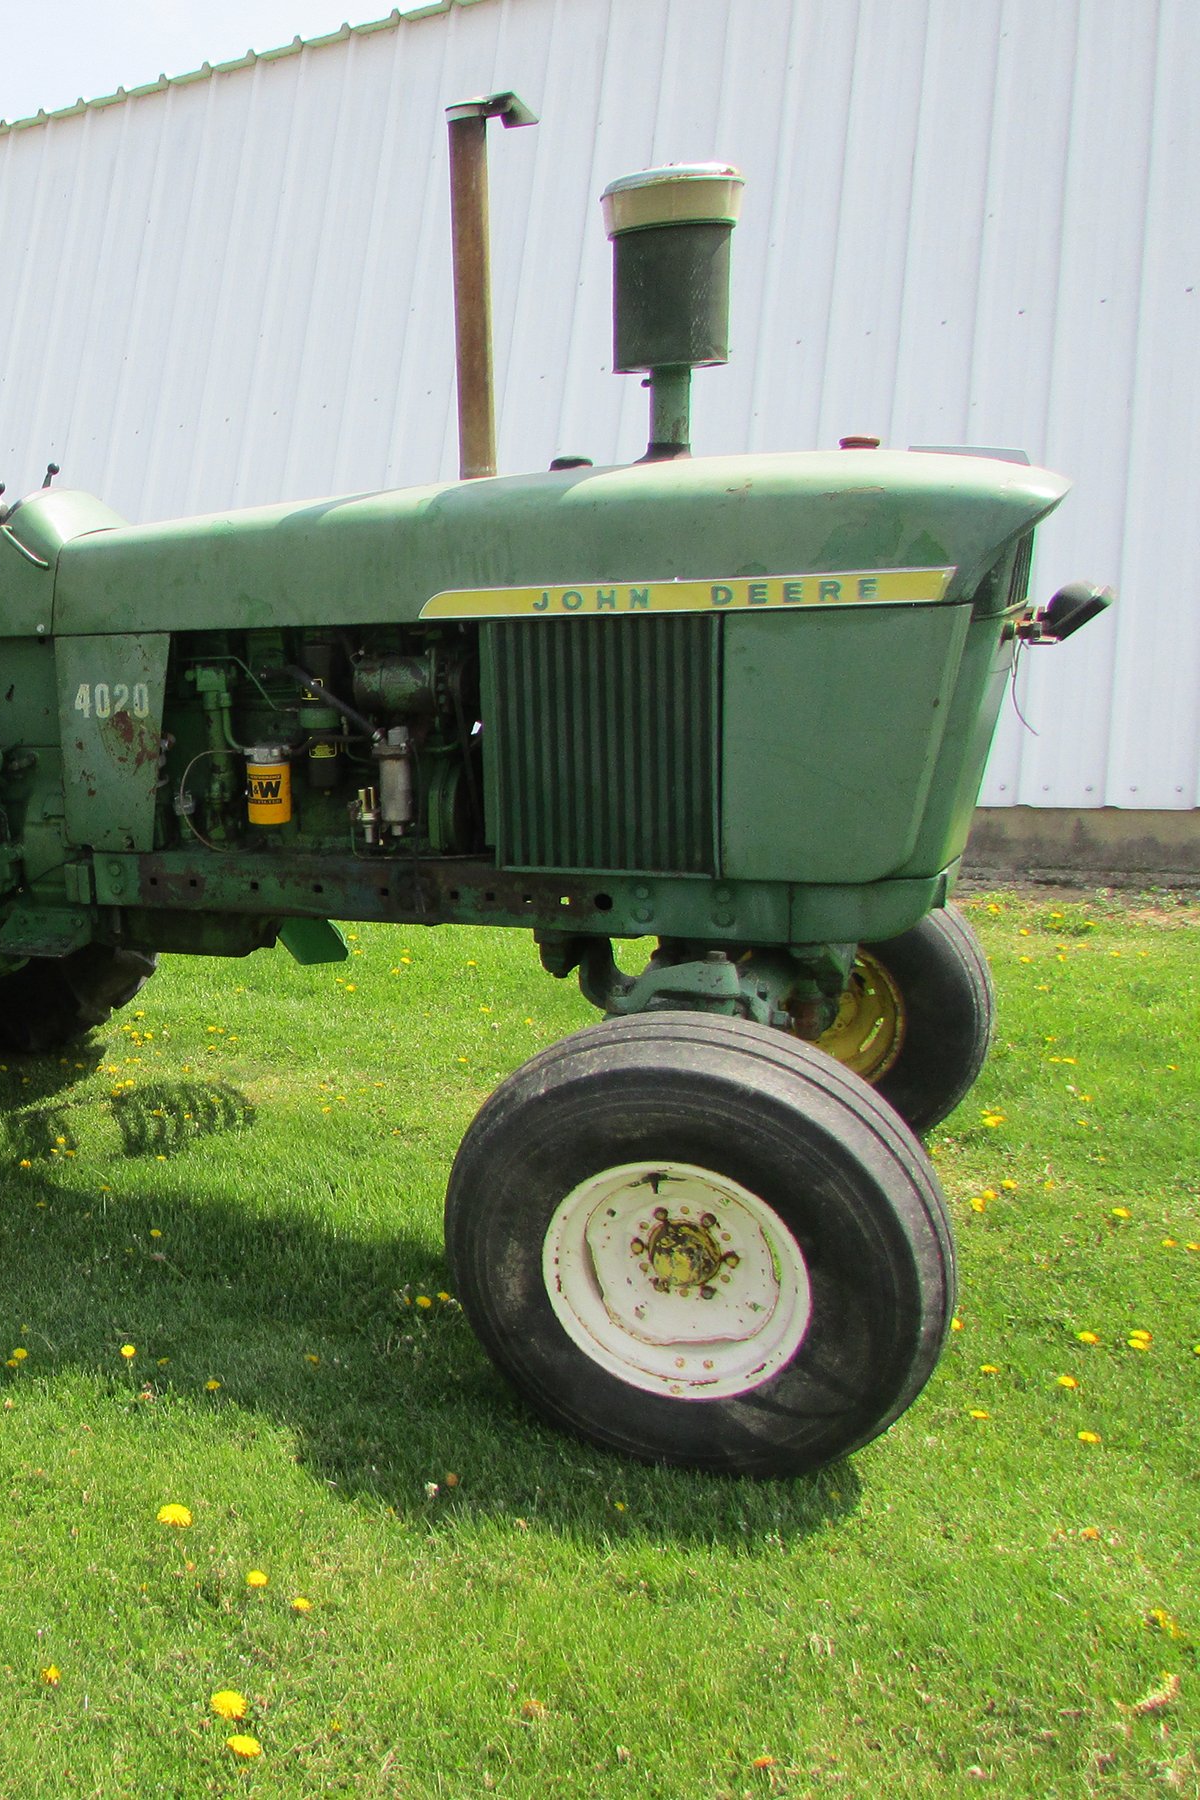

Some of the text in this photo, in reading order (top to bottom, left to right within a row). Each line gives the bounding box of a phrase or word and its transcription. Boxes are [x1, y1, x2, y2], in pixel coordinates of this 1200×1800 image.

[532, 578, 878, 611] JOHN DEERE
[75, 683, 149, 718] 4020
